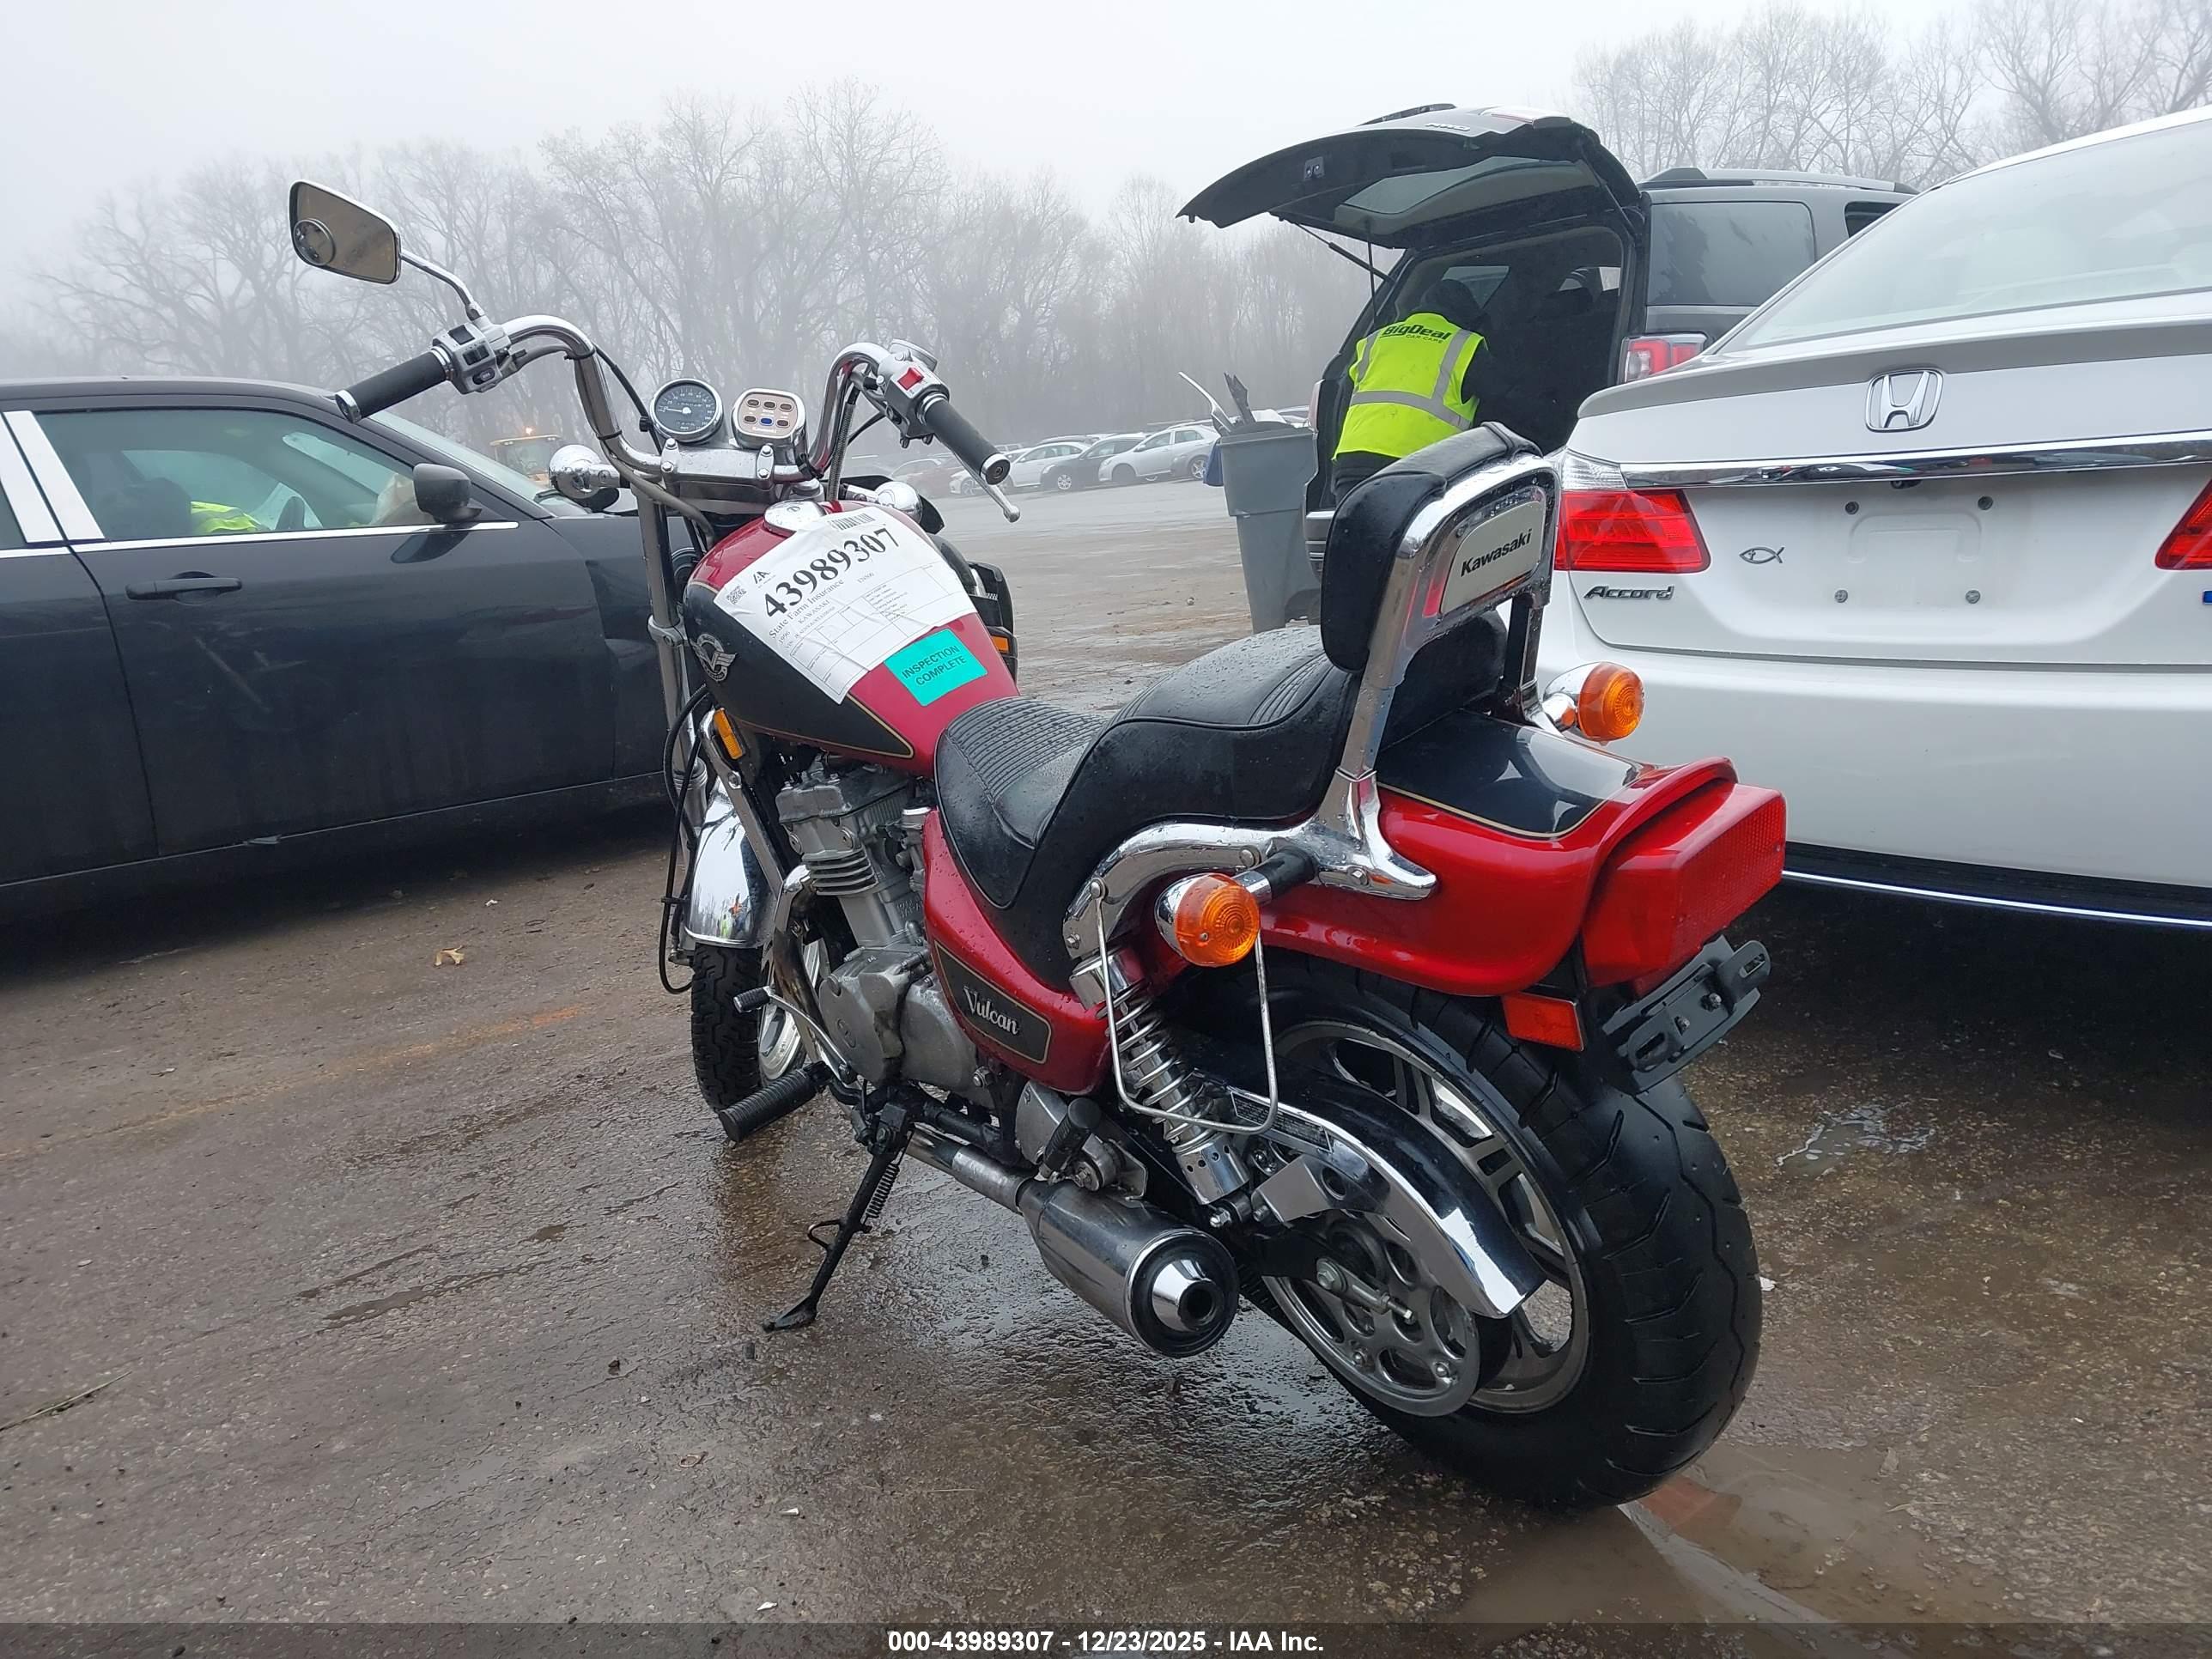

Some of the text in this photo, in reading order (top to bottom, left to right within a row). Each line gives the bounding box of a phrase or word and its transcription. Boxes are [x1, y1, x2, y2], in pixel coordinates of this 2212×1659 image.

[1381, 324, 1452, 340] BigDeal
[765, 527, 899, 617] 43989307
[1461, 528, 1533, 577] Kawasaki
[769, 619, 788, 639] State
[787, 603, 809, 619] Farm
[807, 580, 844, 605] Insurance
[1583, 586, 1675, 600] Accord
[778, 631, 790, 644] 1996
[798, 599, 830, 624] KAWASAKI
[902, 646, 960, 678] INSPECTION
[916, 655, 967, 685] COMPLETE
[963, 985, 1020, 1035] Vulcan
